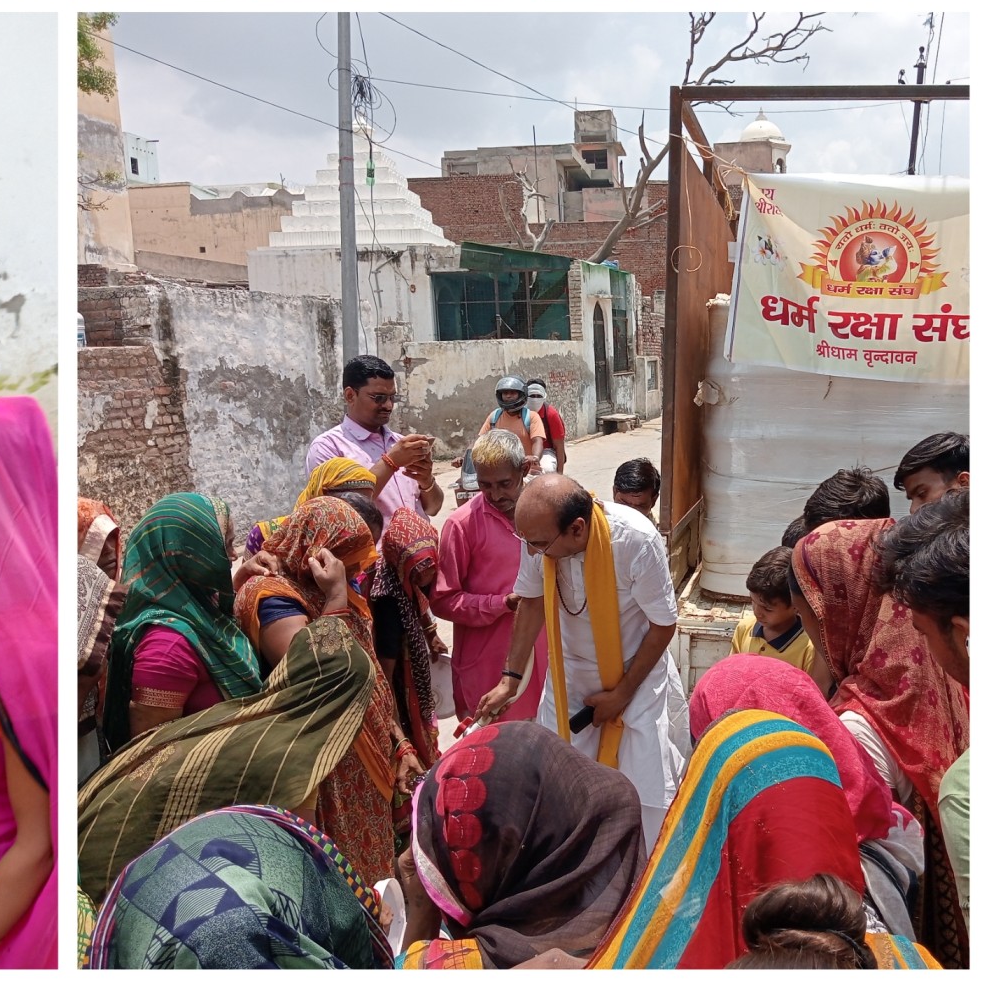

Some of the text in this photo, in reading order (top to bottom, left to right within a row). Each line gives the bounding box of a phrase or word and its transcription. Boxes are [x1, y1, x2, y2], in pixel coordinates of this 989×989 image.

[835, 231, 853, 250] यतो
[879, 223, 900, 234] ततो
[827, 283, 915, 296] धर्म रक्षा संघ
[760, 295, 820, 334] धर्म
[828, 311, 903, 341] रक्षा
[816, 340, 917, 367] श्रीधाम वृन्दावन
